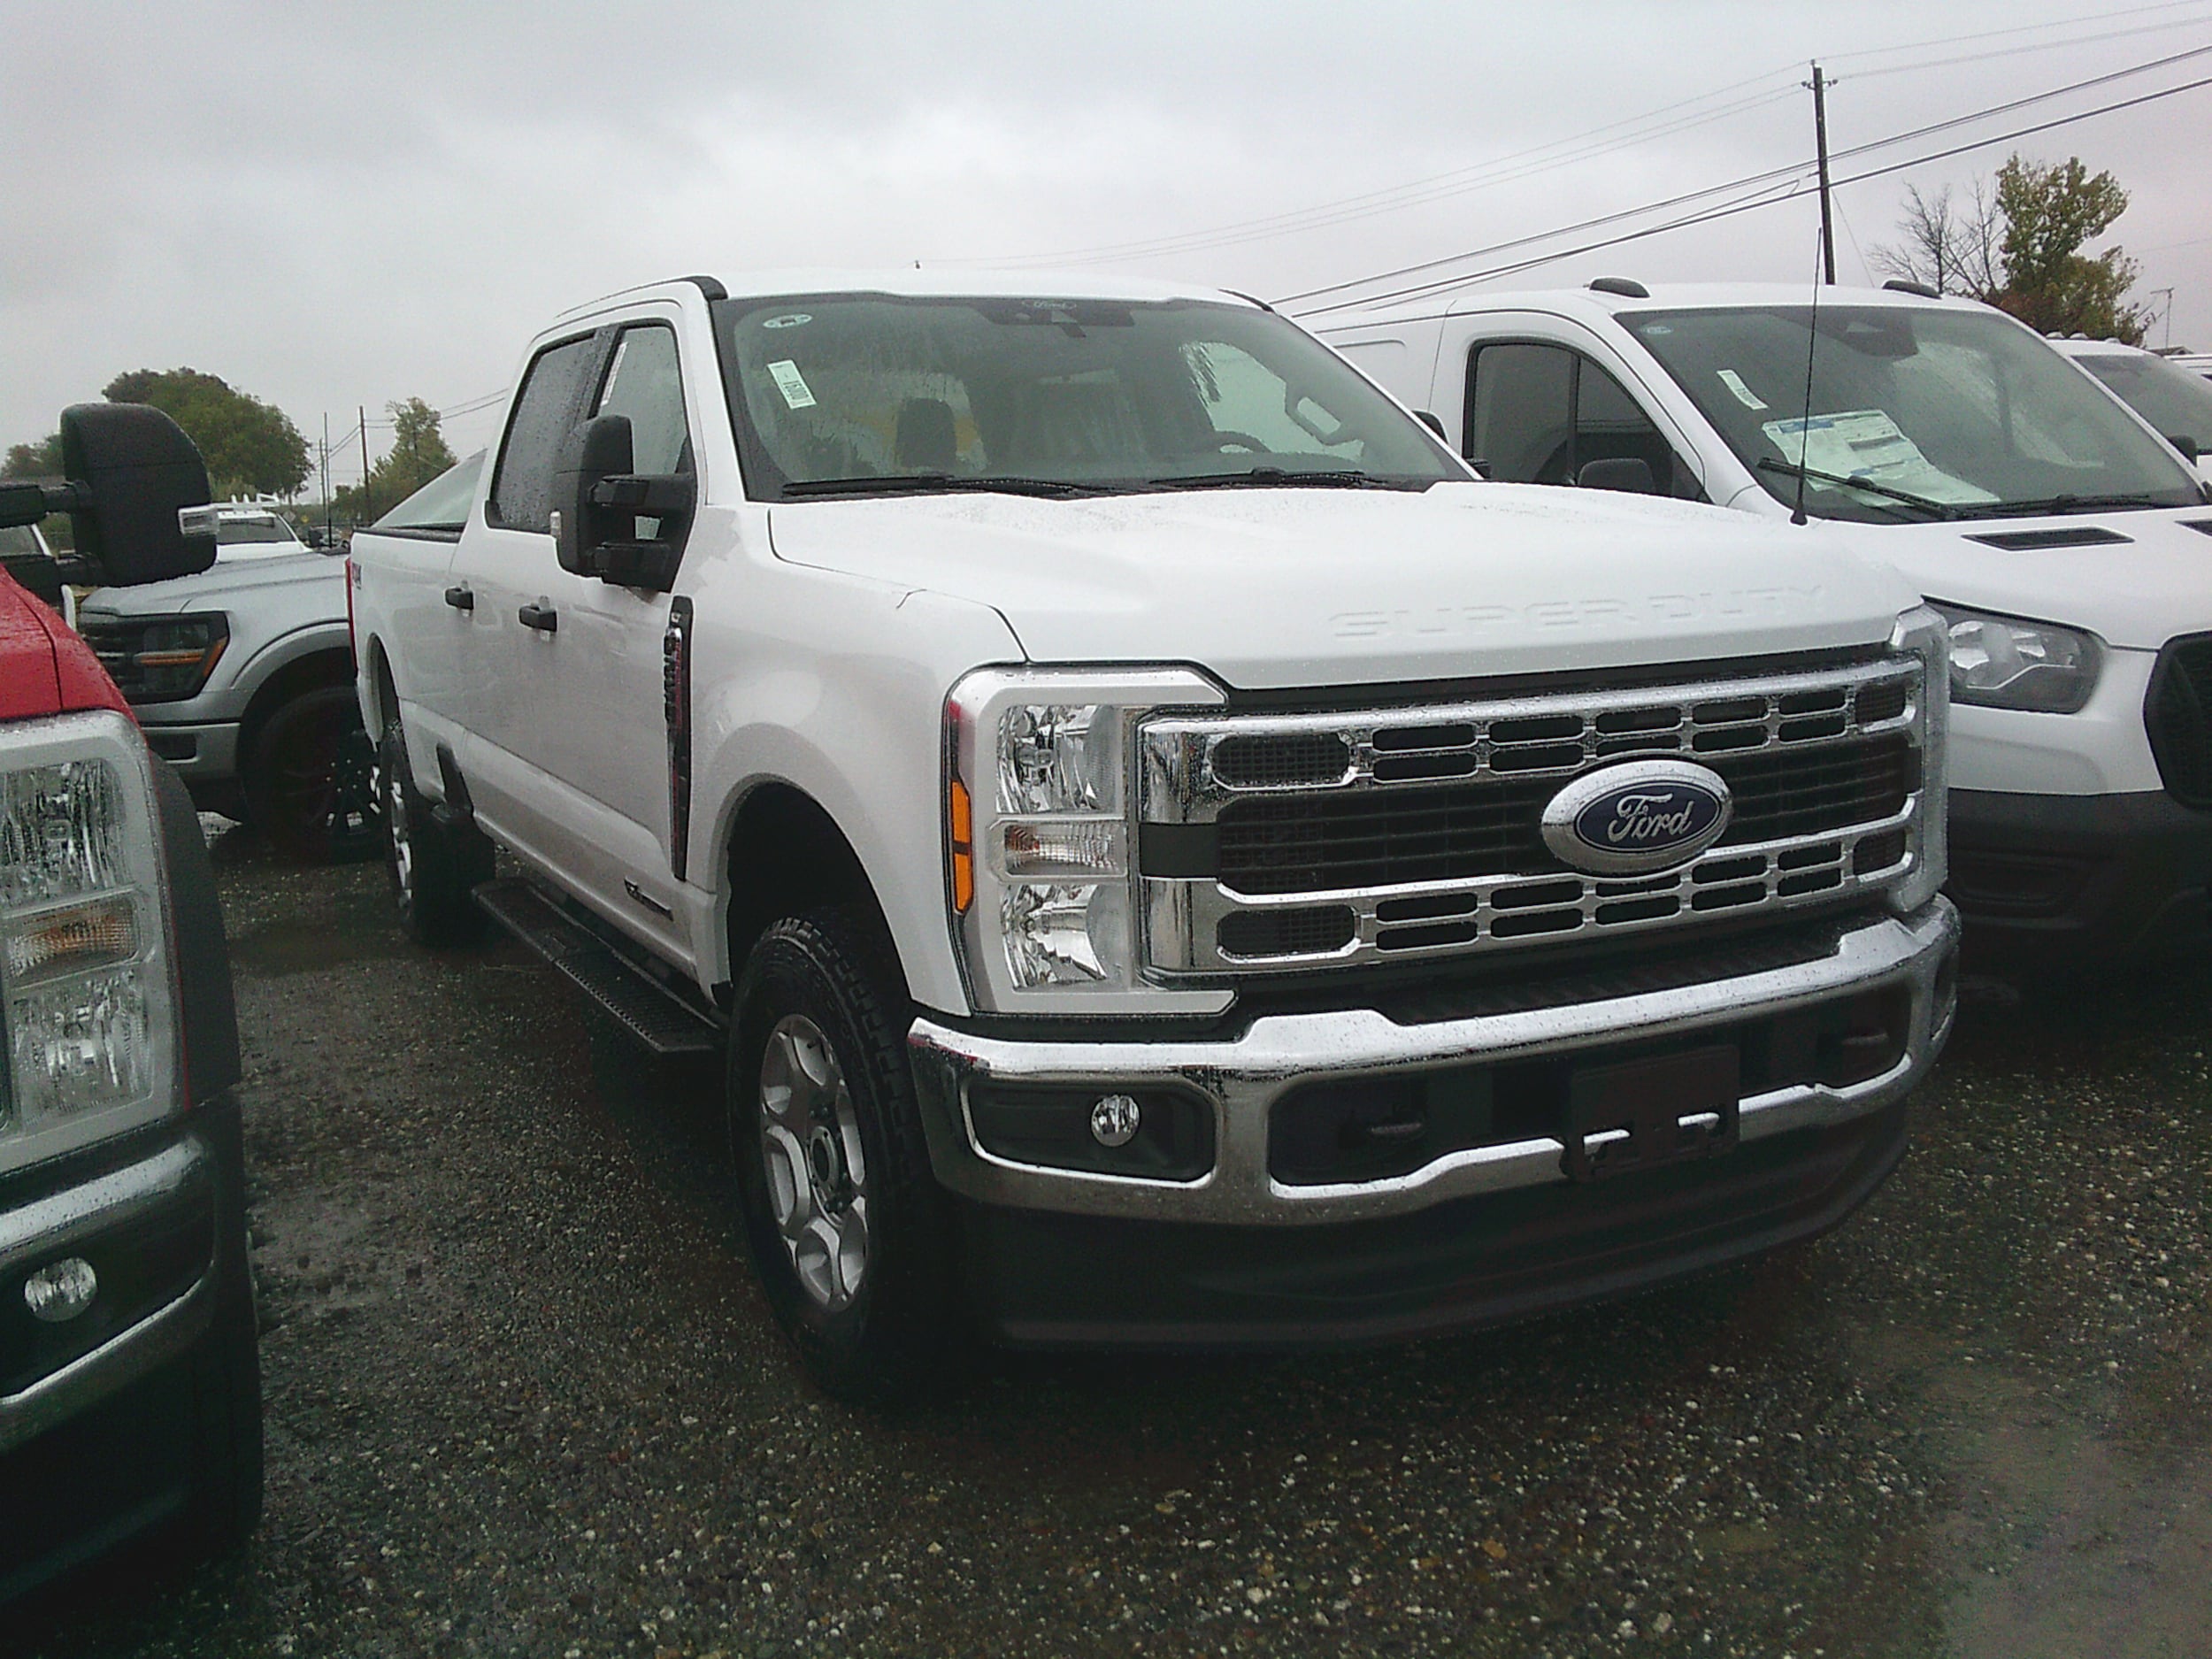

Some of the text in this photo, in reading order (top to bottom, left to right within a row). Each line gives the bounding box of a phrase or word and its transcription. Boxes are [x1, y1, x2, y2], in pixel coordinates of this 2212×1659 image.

[1329, 585, 1824, 637] SUPER DUTY
[1608, 793, 1694, 841] Ford
